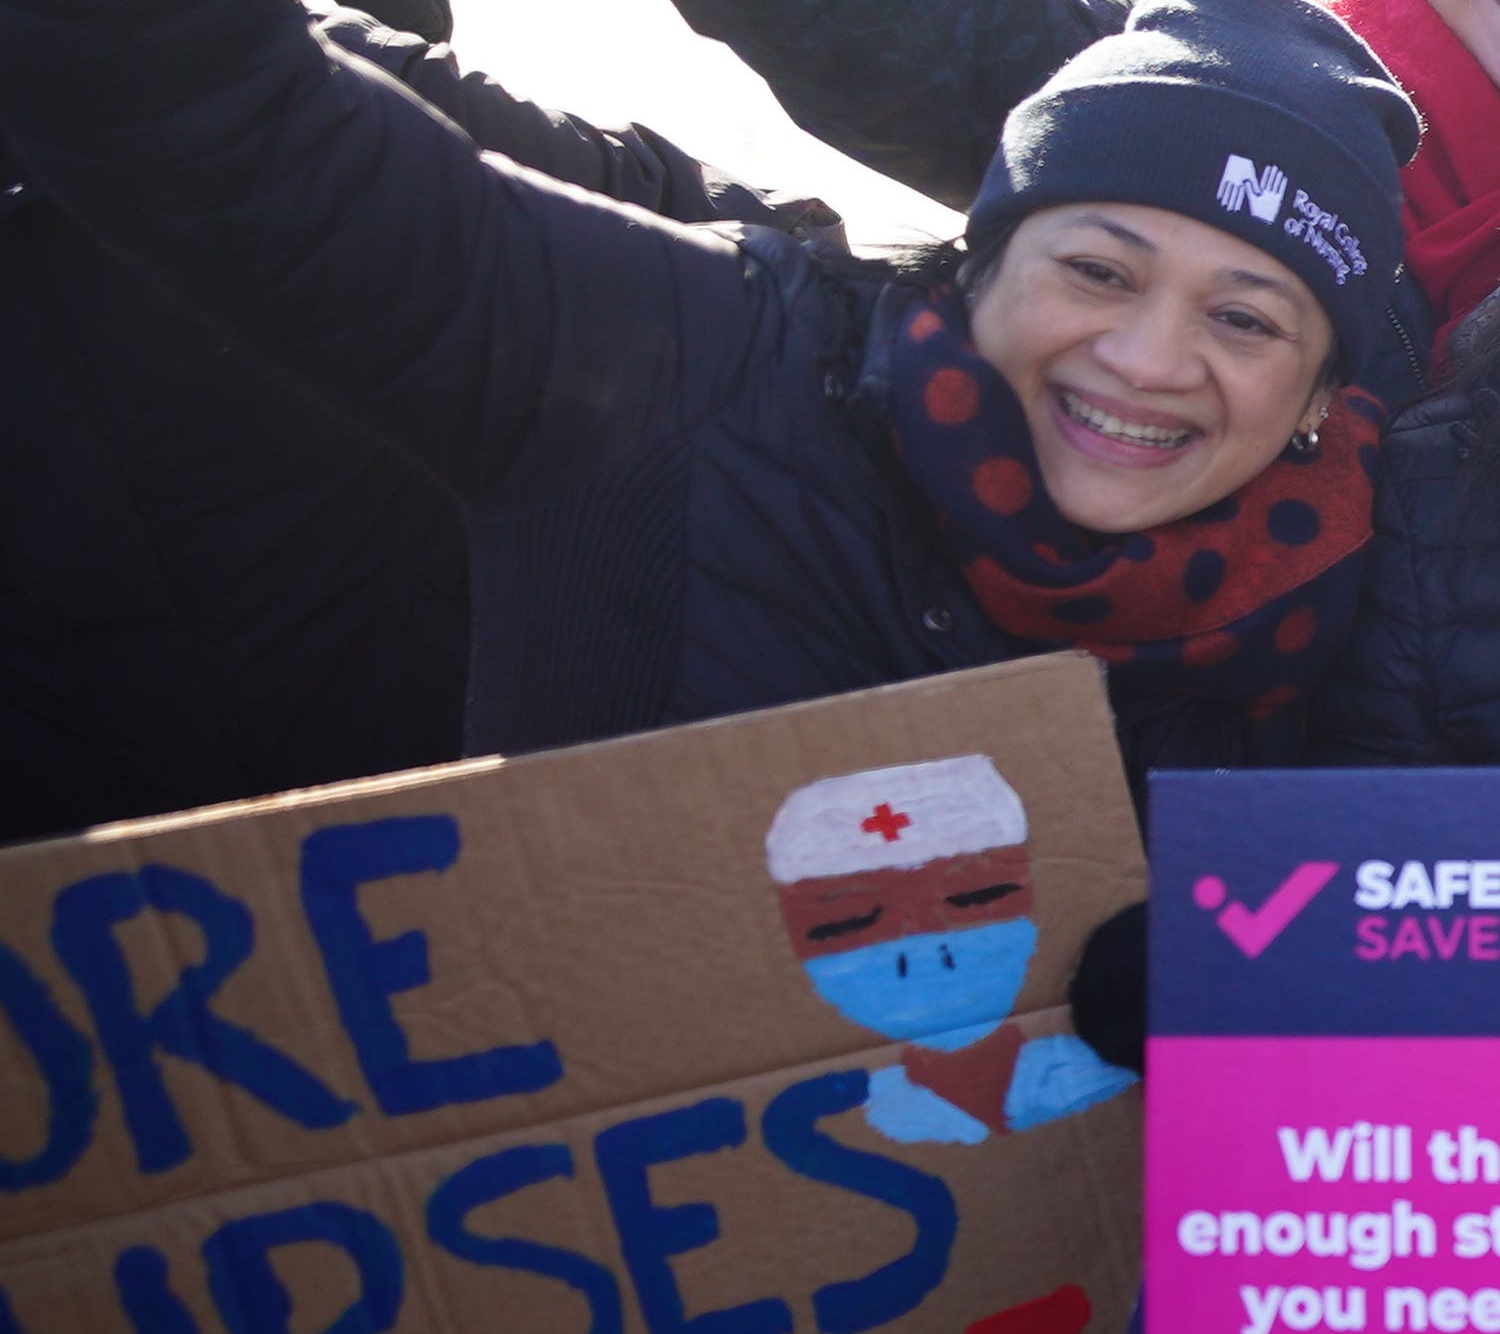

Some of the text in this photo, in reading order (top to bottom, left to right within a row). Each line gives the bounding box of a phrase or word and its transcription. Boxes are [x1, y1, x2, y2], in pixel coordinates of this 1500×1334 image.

[1283, 217, 1306, 237] of
[1292, 189, 1339, 231] Royal
[1277, 1121, 1413, 1183] Will
[1176, 1199, 1437, 1271] enough
